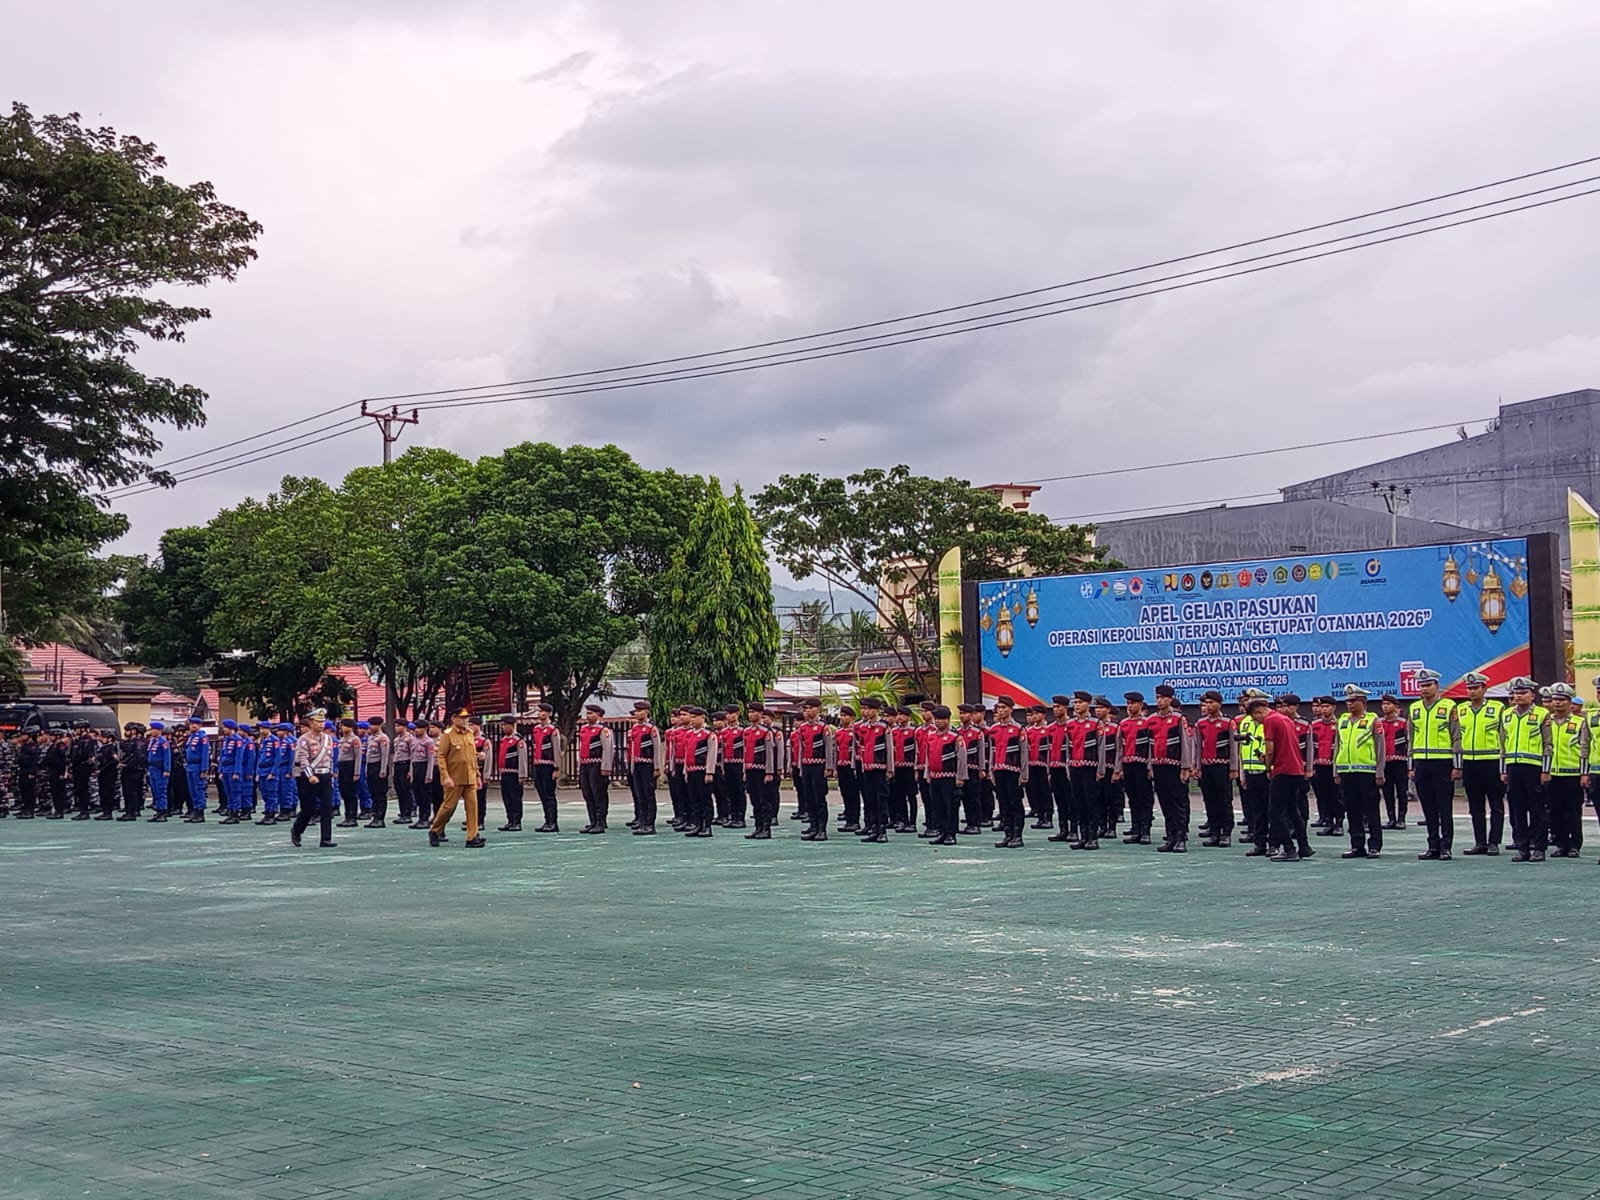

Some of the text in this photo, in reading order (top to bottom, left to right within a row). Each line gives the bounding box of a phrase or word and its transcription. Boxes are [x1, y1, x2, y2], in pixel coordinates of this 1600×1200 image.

[1140, 597, 1316, 624] APEL GELAR PASUKAN
[1049, 631, 1099, 646] OPERASI
[1102, 626, 1174, 643] KEPOLISIAN
[1177, 622, 1243, 638] TERPUSAT
[1317, 614, 1385, 632] OTANAHA
[1174, 639, 1279, 656] DALAM RANGKA
[1101, 652, 1367, 677] PELAYANAN PERAYAAN IDUL FITRI 1447 H
[1163, 675, 1288, 689] GORONTALO, 12 MARET 2026
